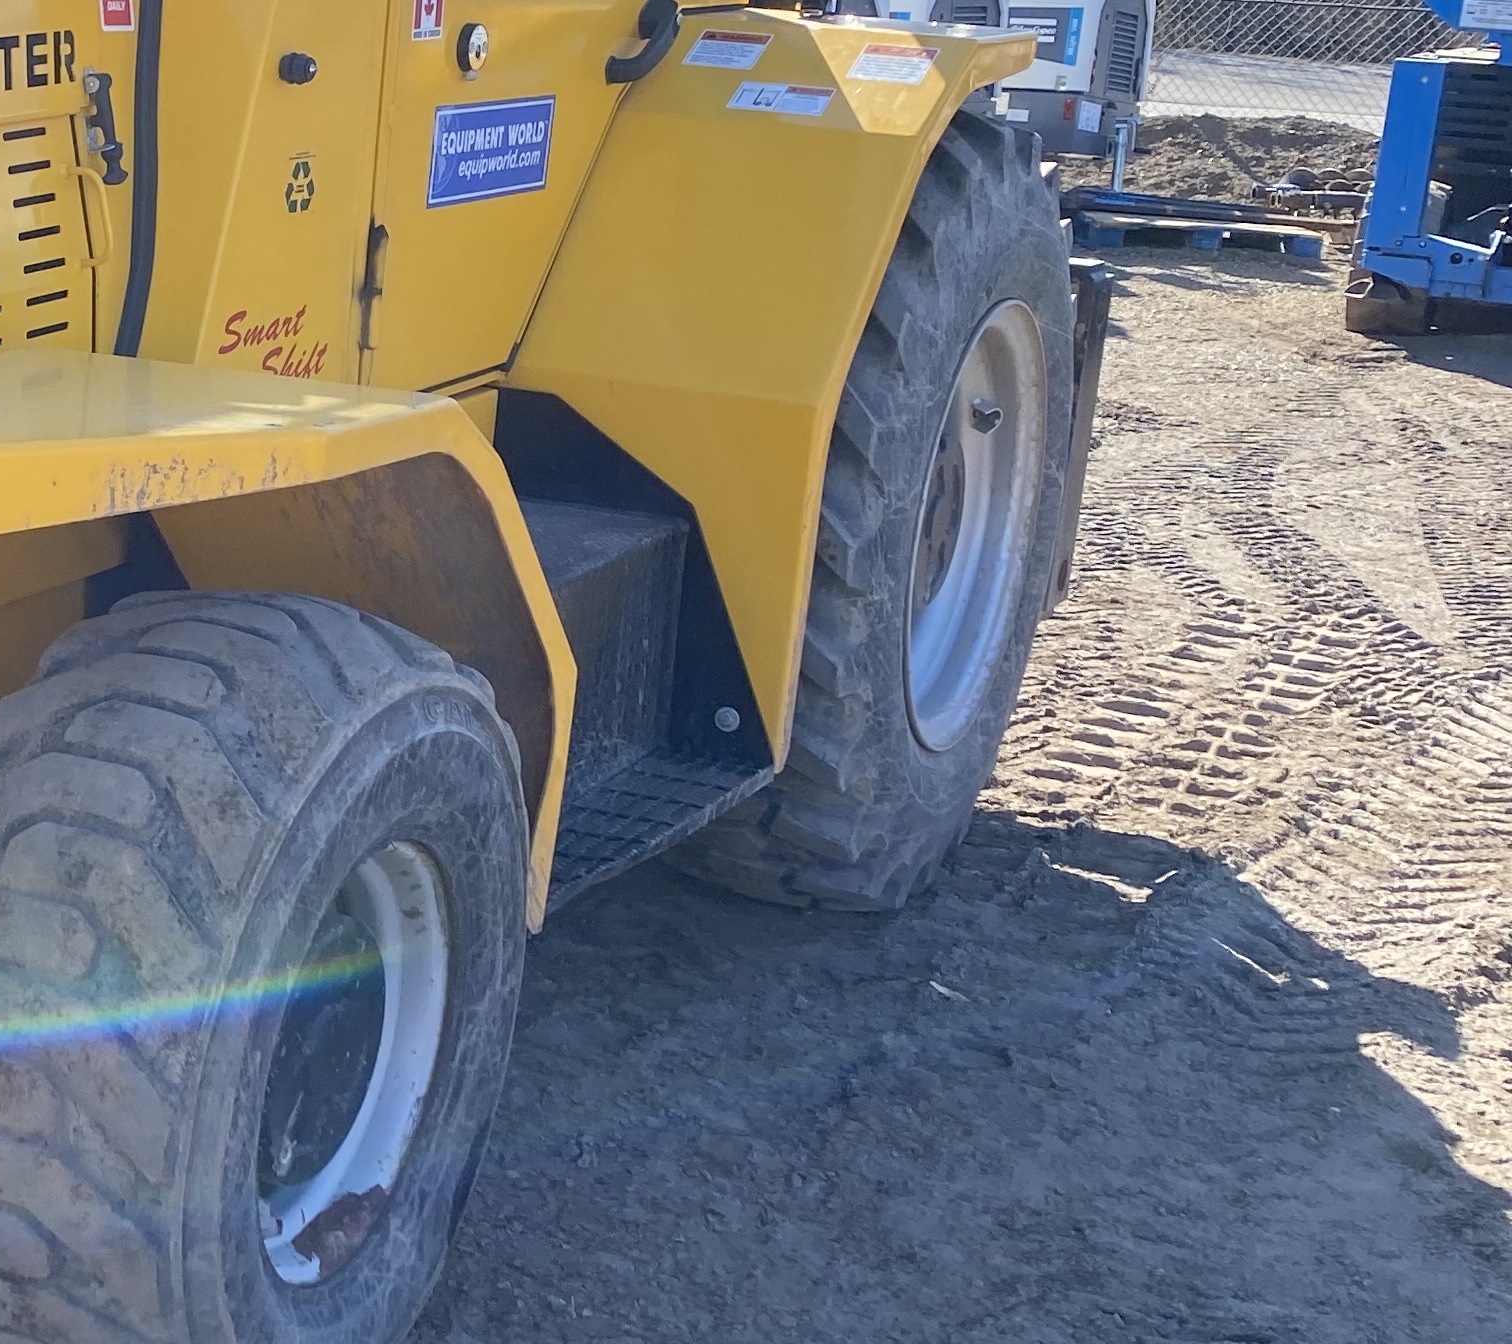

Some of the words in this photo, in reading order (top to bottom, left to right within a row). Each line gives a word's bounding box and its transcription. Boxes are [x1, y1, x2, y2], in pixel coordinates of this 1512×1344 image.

[107, 0, 126, 11] DAILY
[440, 124, 505, 157] EQUIPMENT
[508, 119, 546, 148] WORLD
[458, 148, 542, 181] equipworld.com
[218, 303, 308, 355] Smart
[262, 340, 329, 380] Shift
